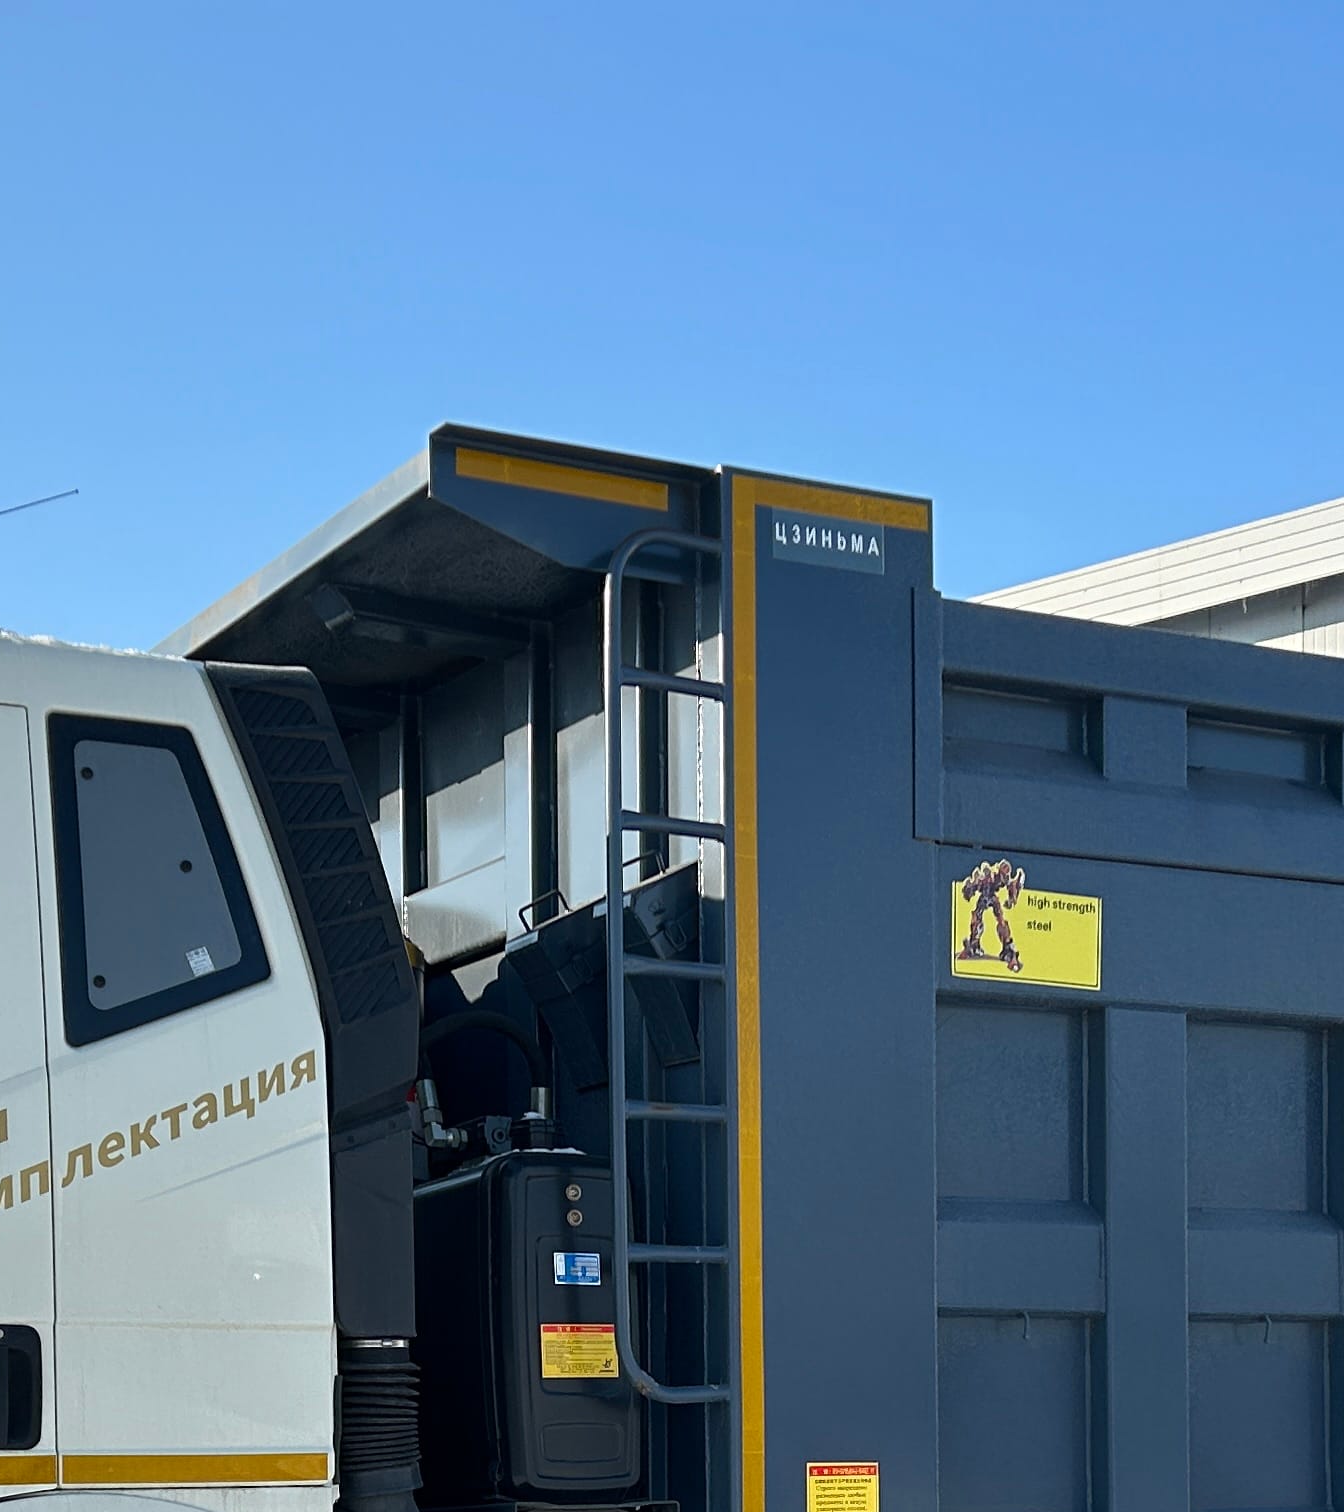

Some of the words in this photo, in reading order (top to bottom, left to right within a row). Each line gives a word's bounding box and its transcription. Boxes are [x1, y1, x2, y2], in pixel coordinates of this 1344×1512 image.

[775, 521, 880, 557] ЦЗИНЬМА
[1027, 895, 1050, 910] high
[1052, 900, 1096, 915] strength
[1027, 920, 1052, 932] steel
